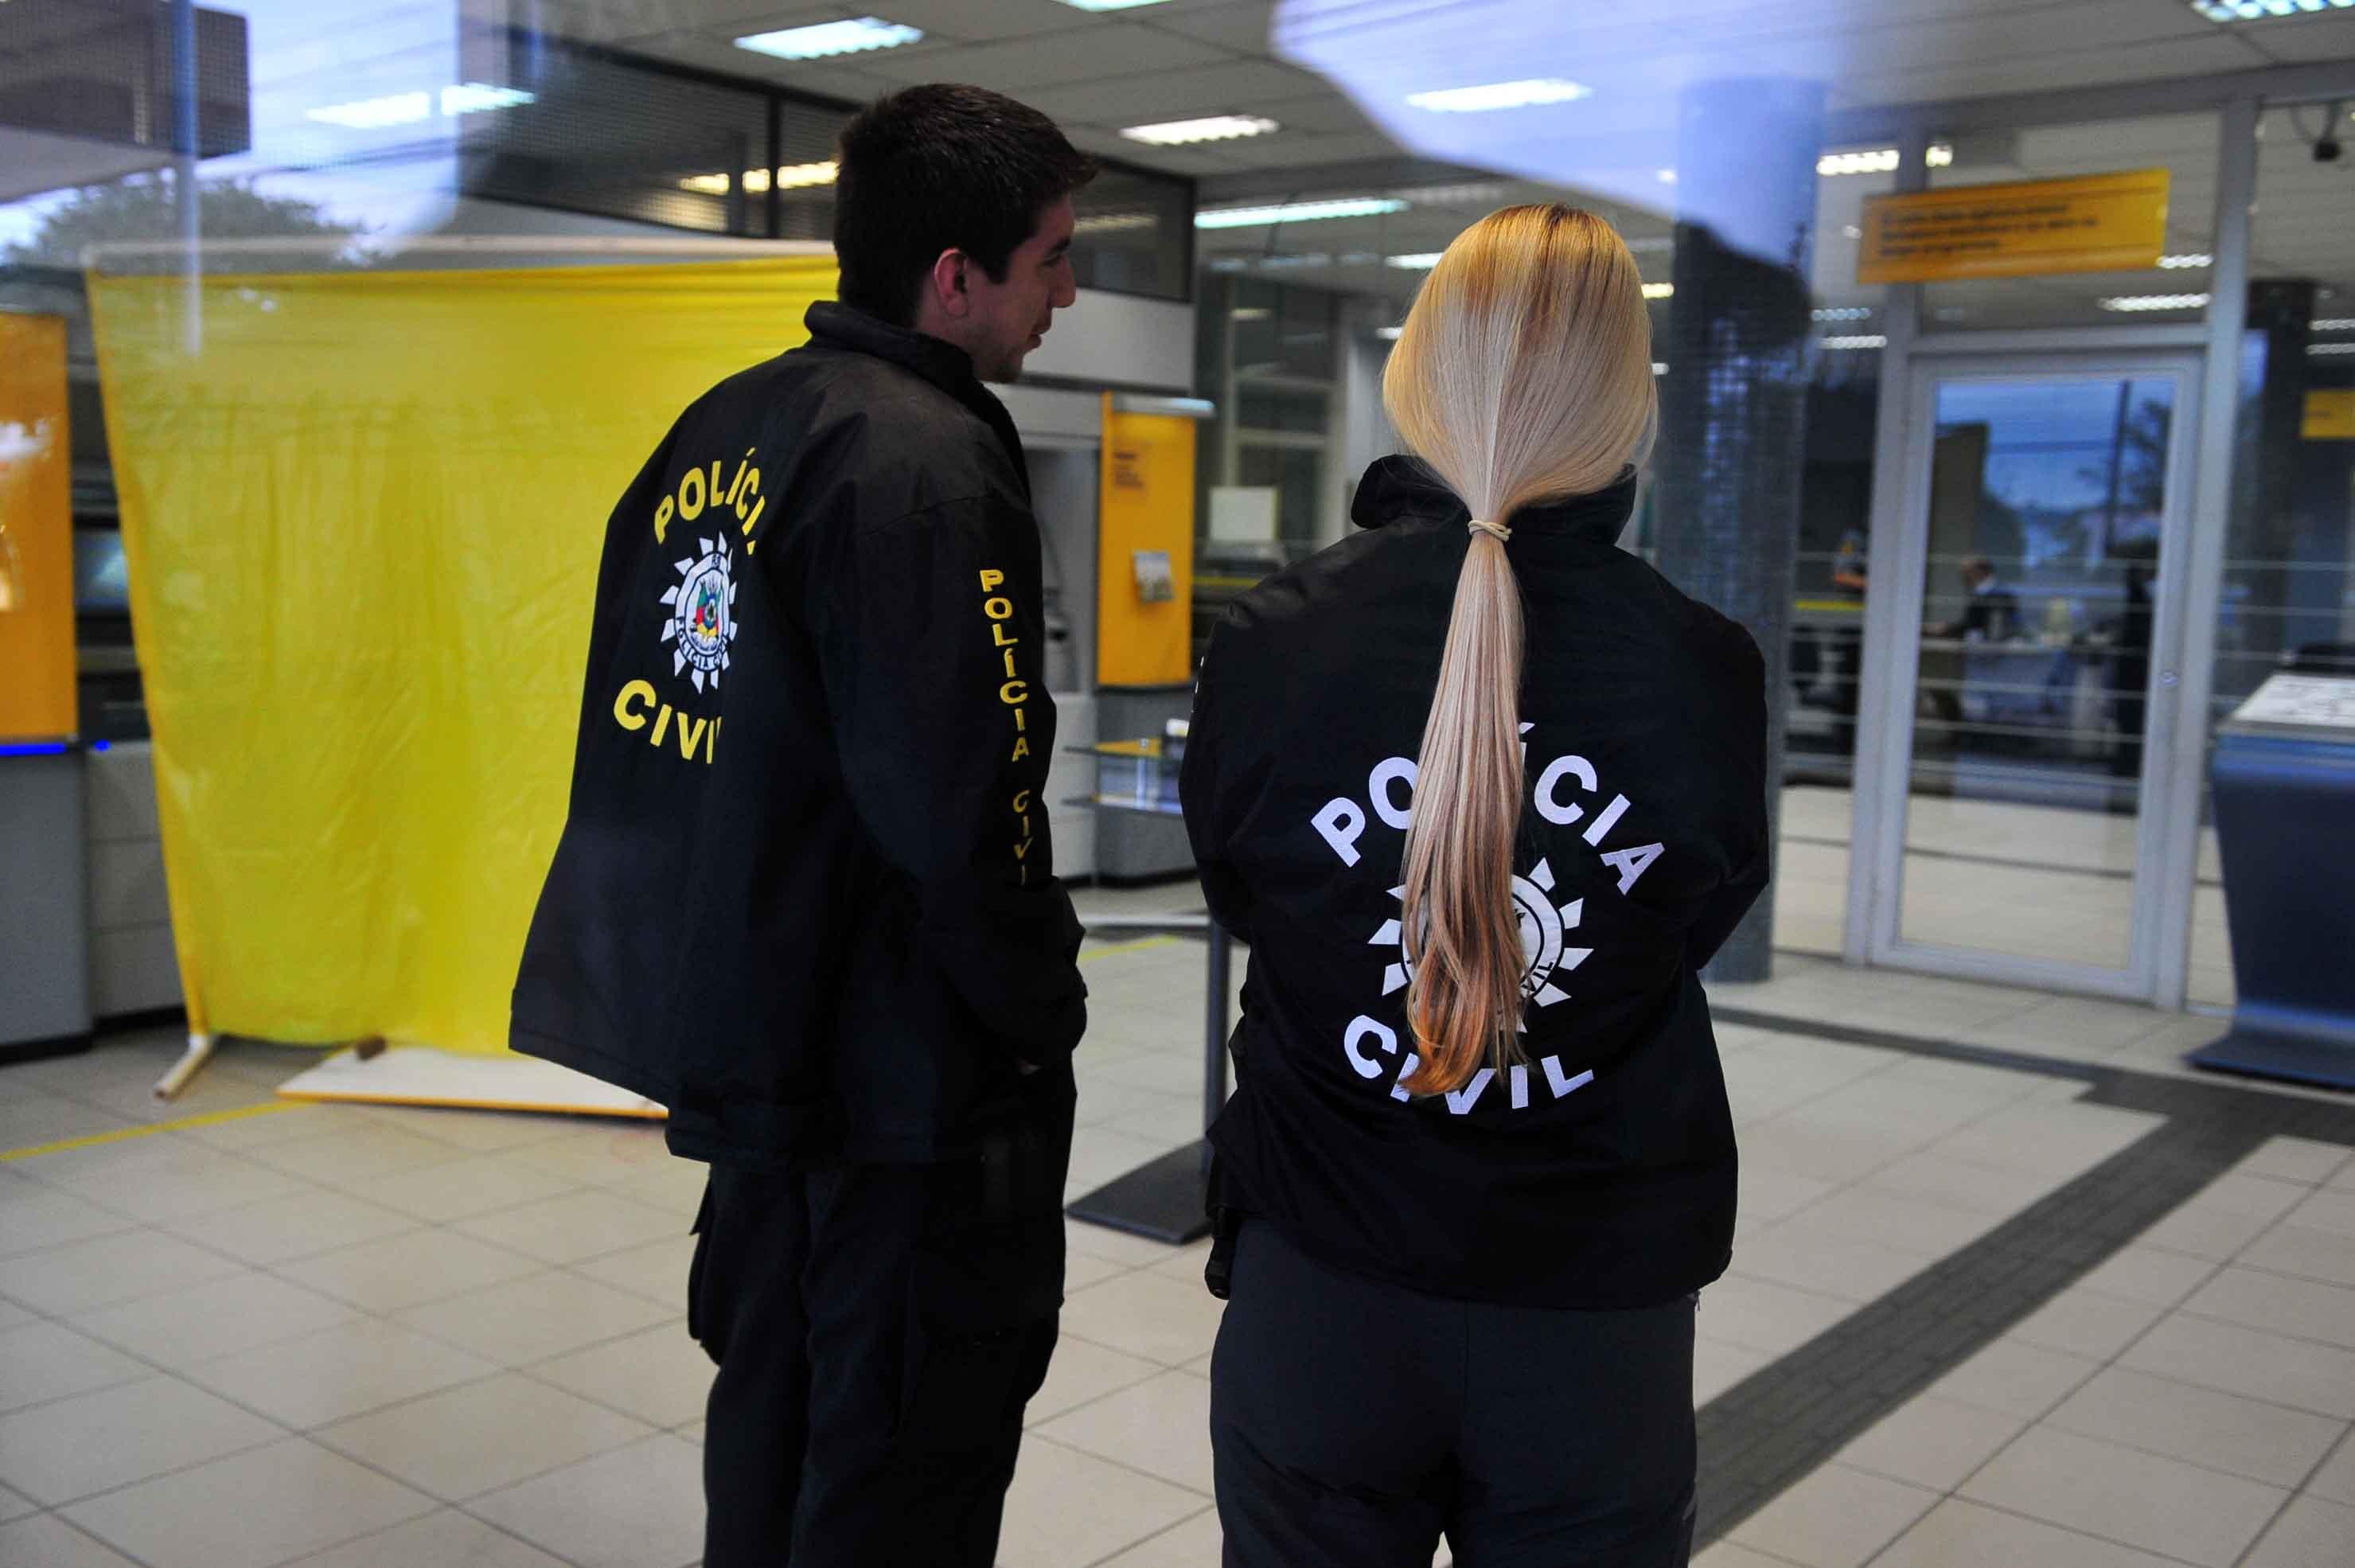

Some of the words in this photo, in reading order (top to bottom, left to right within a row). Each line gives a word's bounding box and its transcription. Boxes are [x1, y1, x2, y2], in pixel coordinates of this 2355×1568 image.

[653, 447, 766, 556] POLÍCI
[979, 568, 1030, 763] POLÍCIA
[1012, 790, 1034, 886] CIVI
[1311, 721, 1665, 895] POCIA
[1343, 1014, 1595, 1115] CIVIL
